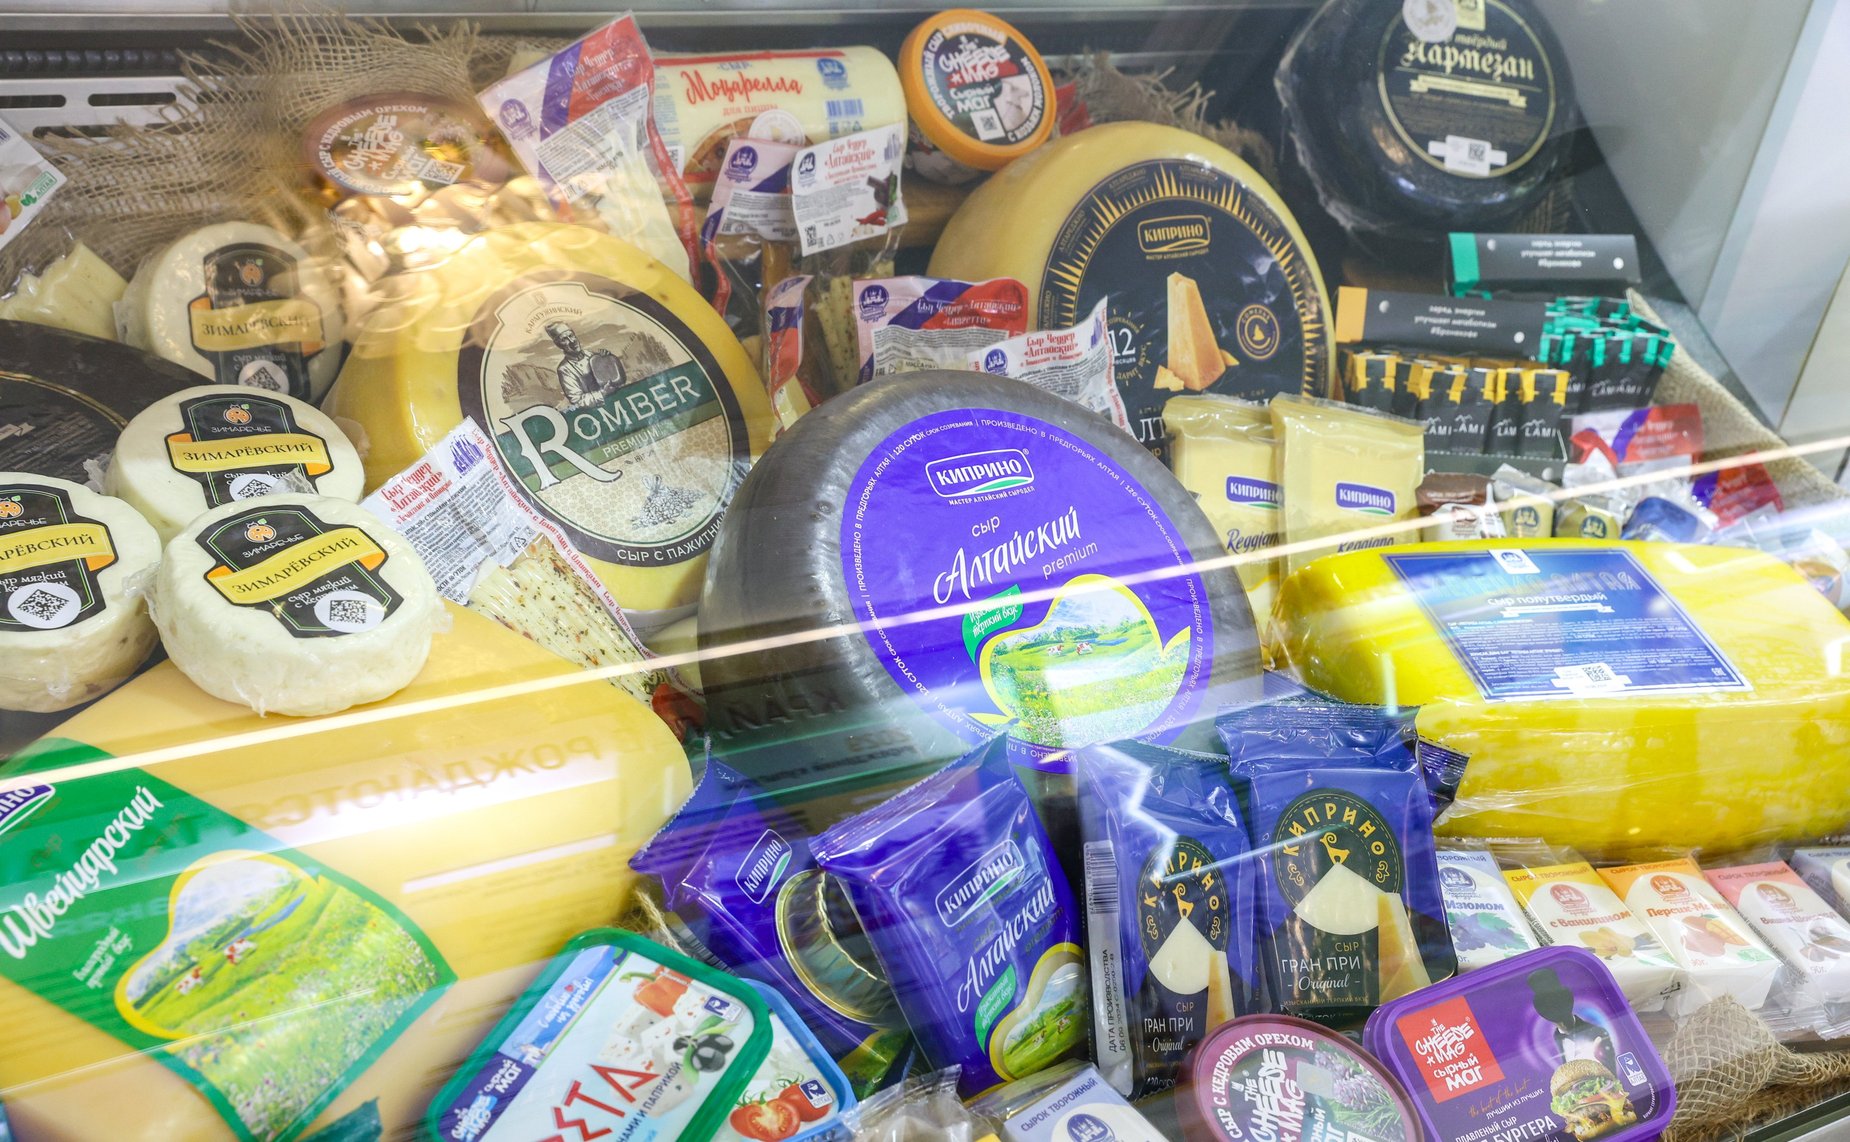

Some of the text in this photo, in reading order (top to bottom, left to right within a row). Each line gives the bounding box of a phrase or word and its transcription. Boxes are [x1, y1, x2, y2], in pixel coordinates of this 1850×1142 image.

[681, 70, 803, 106] Моцарелла
[1143, 223, 1204, 243] КИПРИНО
[211, 425, 272, 434] ЗИМАРЕЧЬЕ
[903, 431, 926, 447] СУТОК
[925, 428, 941, 437] СРОК
[940, 421, 974, 432] СОЗРЕВАНИЯ
[183, 442, 315, 462] ЗИМАРЁВСКИЙ
[603, 428, 658, 458] PREMIUM
[873, 457, 891, 478] АЛТАЯ
[936, 459, 1023, 487] КИПРИНО
[981, 419, 1037, 436] ПРОИЗВЕДЕНО
[1041, 430, 1046, 438] В
[1049, 434, 1096, 463] ПРЕДГОРЬЯХ
[1097, 461, 1120, 482] АЛТАЯ
[1125, 484, 1137, 498] 120
[1136, 494, 1159, 523] СУТОК
[855, 477, 878, 521] ПРЕДГОРЬЯХ
[949, 486, 1036, 507] МАСТЕР АЛТАЙСКИЙ СЫРОДЕЛ
[1339, 489, 1391, 508] КИПРИНО
[971, 515, 1001, 538] сыр
[242, 533, 304, 559] ЗИМАРЕЧЬЕ
[1227, 529, 1280, 553] Reggian
[231, 538, 359, 594] ЗИМАРЁВСКИЙ
[616, 548, 649, 562] СЫР
[655, 551, 665, 562] С
[853, 531, 867, 592] ПРОИЗВЕДЕНО
[932, 505, 1082, 605] Алтайский
[1042, 540, 1099, 580] premium
[21, 571, 66, 582] мягкий
[287, 576, 353, 604] сыр мягкий
[893, 655, 918, 684] СУТОК
[1282, 802, 1386, 857] КИПРИНО
[0, 784, 165, 960] Швейцарский
[744, 839, 783, 895] КИПРИНО
[1511, 872, 1537, 882] СЫРОК
[944, 851, 1017, 915] КИПРИНО
[1445, 898, 1505, 911] Изюмом
[957, 876, 1057, 1014] Алтайский
[1334, 940, 1361, 953] СЫР
[1281, 955, 1362, 974] ГРАН ПРИ
[1297, 975, 1350, 993] Original
[1176, 1001, 1194, 1013] СЫР
[1144, 1015, 1195, 1035] ГРАН ПРИ
[1431, 1022, 1447, 1034] THE
[1152, 1035, 1185, 1056] Original
[1414, 1020, 1476, 1057] CHEESE
[1434, 1042, 1467, 1065] MAG
[1433, 1053, 1480, 1080] сырный
[643, 1059, 684, 1113] ПАПРИКОЙ
[1211, 1032, 1315, 1140] СЫР С КЕДРОВЫМ ОРЕХОМ
[1244, 1077, 1258, 1102] THE
[1445, 1066, 1485, 1093] маг
[1020, 1077, 1099, 1133] СЫРОК ТВОРОЖНЫЙ
[1512, 1088, 1545, 1107] ИЗ ЛУЧШИХ
[1455, 1115, 1518, 1142] ПЛАВЛЕНЫЙ СЫР
[1493, 1115, 1558, 1142] БУРГЕРА
